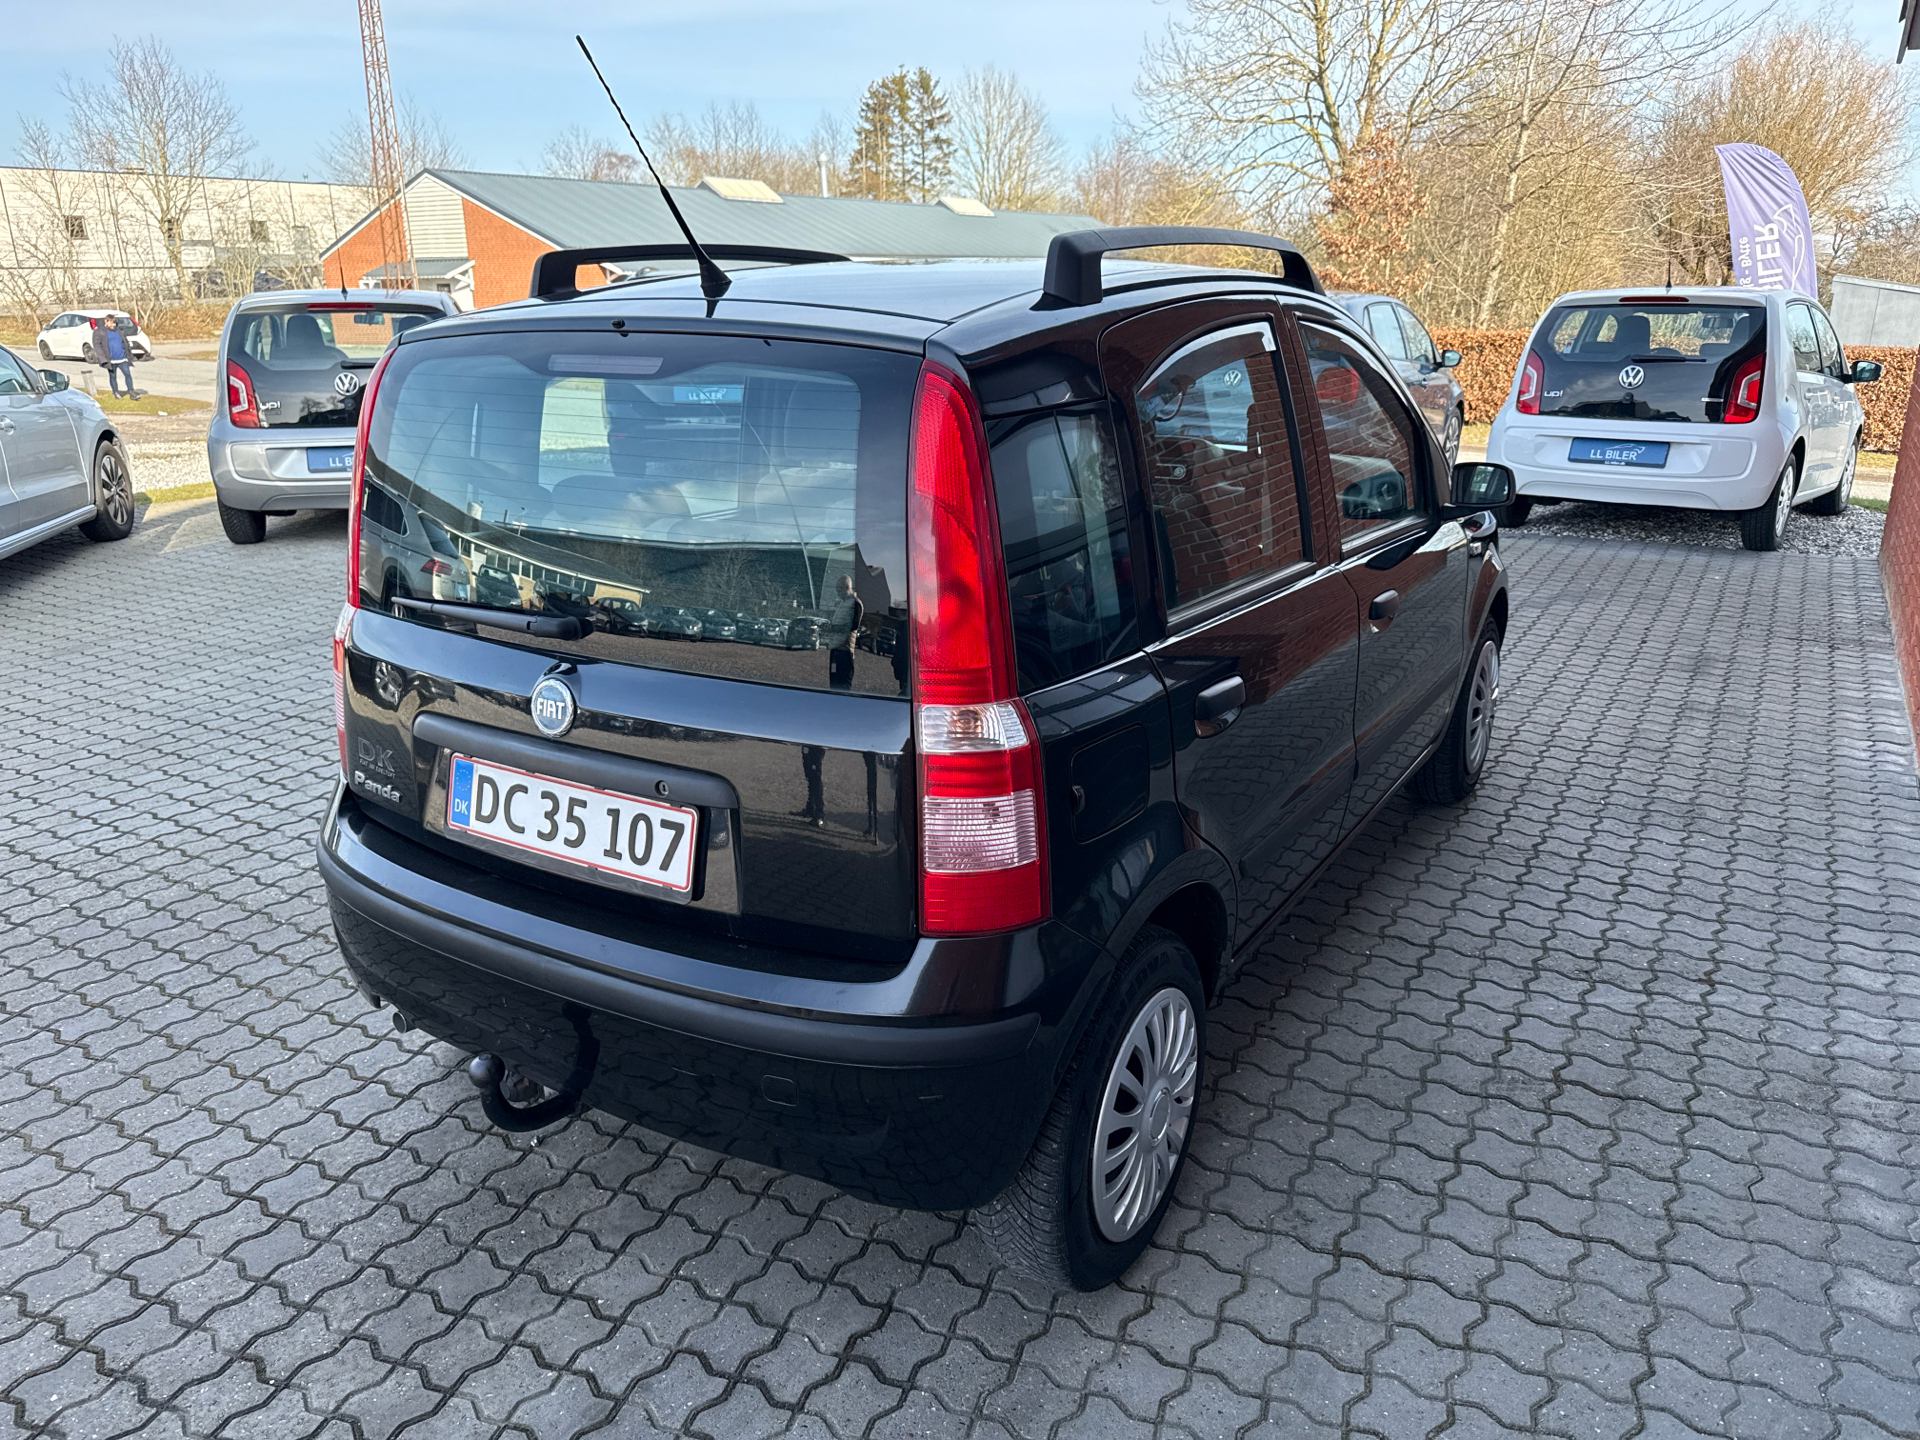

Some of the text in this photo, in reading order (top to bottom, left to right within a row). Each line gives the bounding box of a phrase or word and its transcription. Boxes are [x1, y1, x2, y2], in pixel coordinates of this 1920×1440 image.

[329, 457, 343, 467] LL
[1590, 449, 1637, 461] LL BILER
[536, 697, 566, 720] FIAT
[358, 736, 395, 772] DK
[354, 770, 401, 803] Panda
[454, 798, 468, 816] DK
[475, 774, 685, 872] DC 35 107
